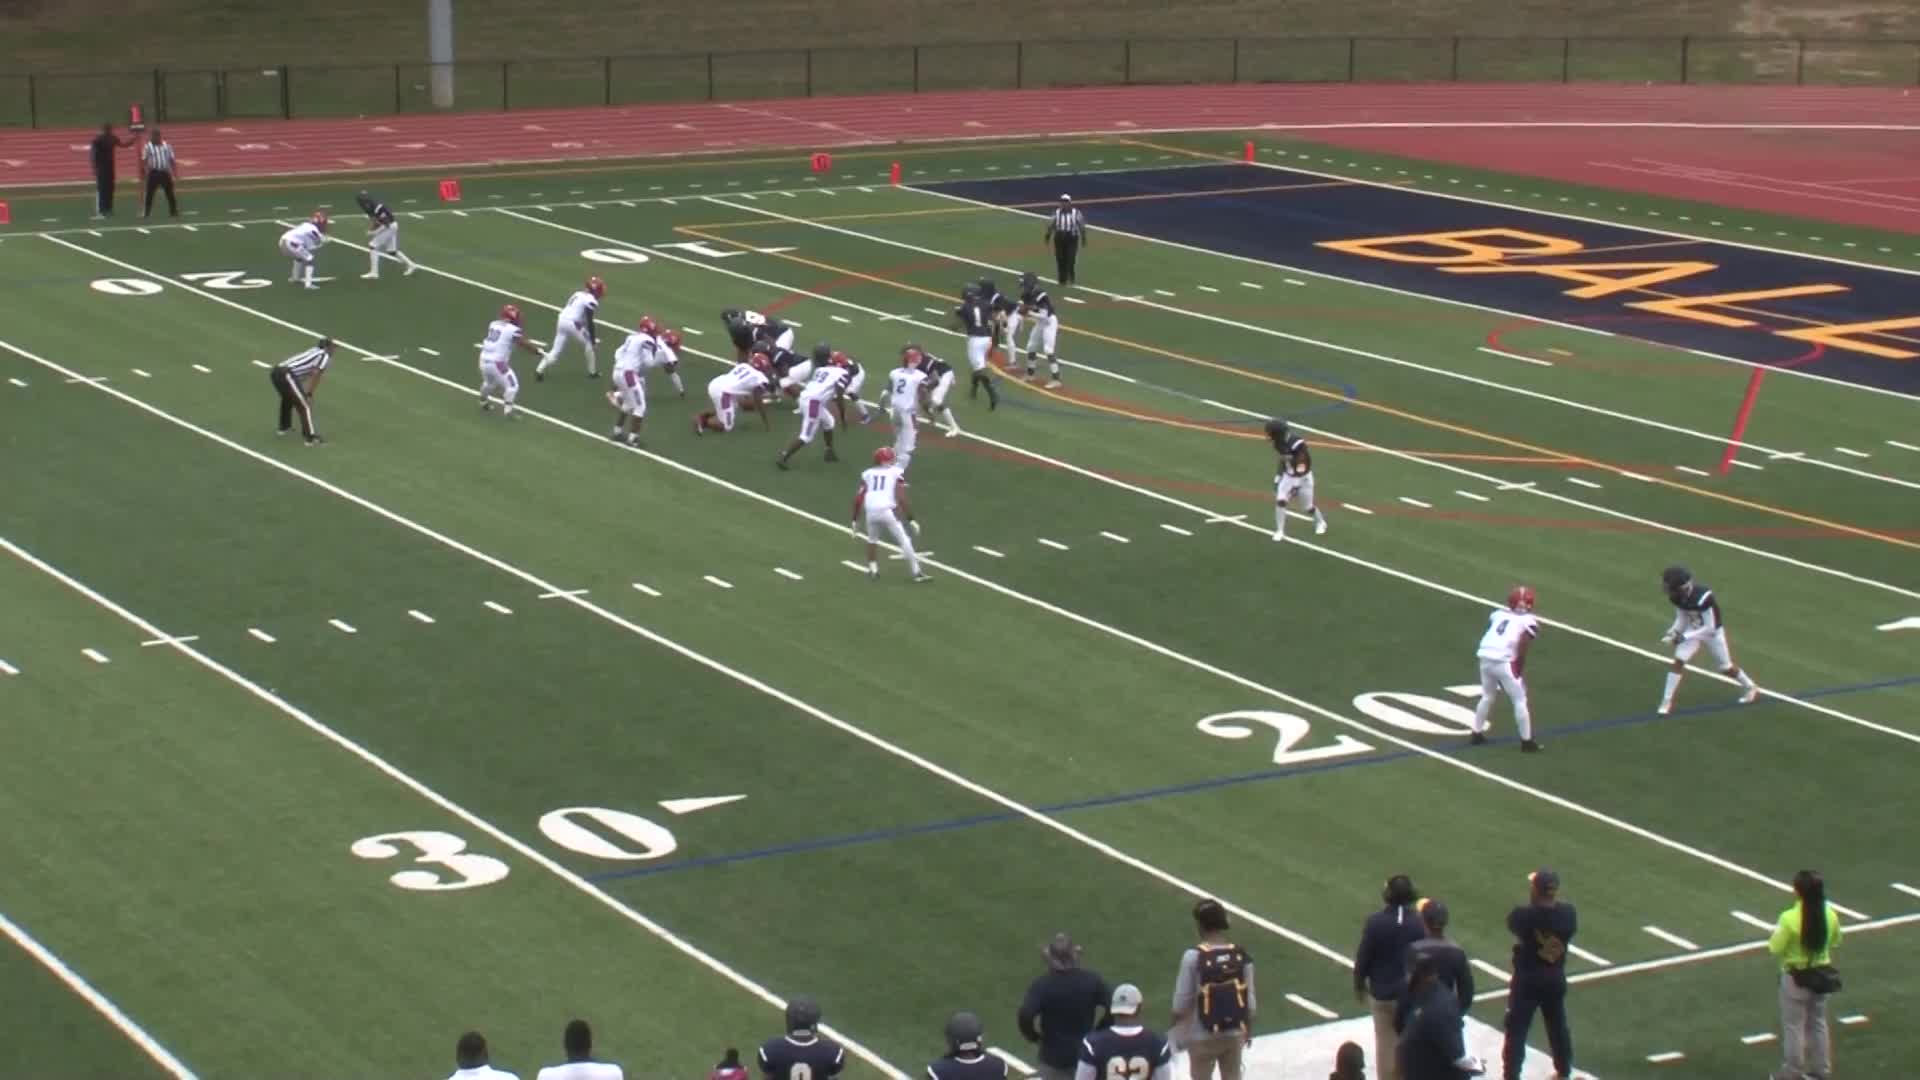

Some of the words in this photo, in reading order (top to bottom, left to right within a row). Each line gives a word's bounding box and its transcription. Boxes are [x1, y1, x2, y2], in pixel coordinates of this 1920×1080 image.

[974, 306, 982, 327] 1
[896, 378, 907, 394] 2
[872, 475, 886, 491] 11
[1495, 619, 1509, 636] 4
[1197, 691, 1491, 764] 20
[351, 807, 678, 891] 30
